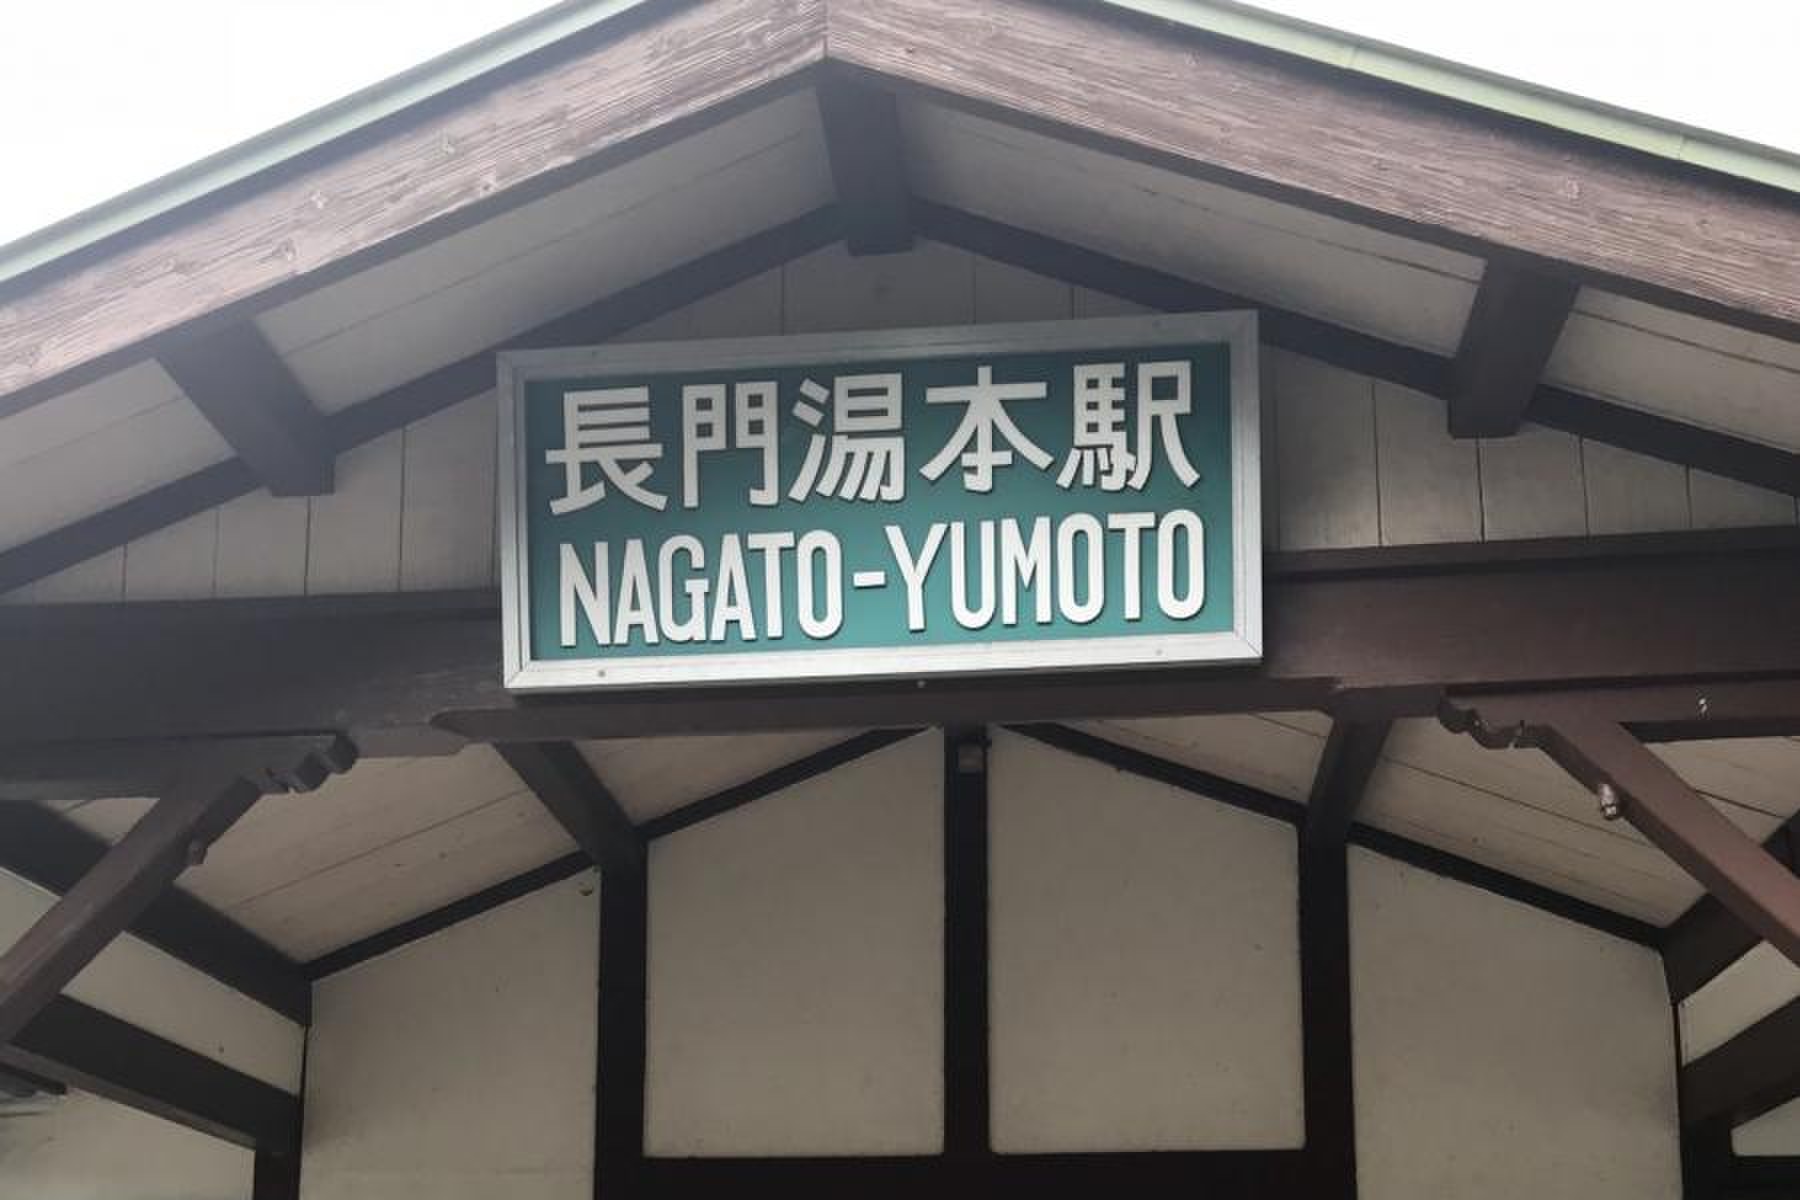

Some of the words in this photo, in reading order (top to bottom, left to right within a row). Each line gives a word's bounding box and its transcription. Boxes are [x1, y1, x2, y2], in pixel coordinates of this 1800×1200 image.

[546, 361, 1201, 513] 長門湯本駅
[559, 509, 1206, 648] NAGATO-YUMOTO
